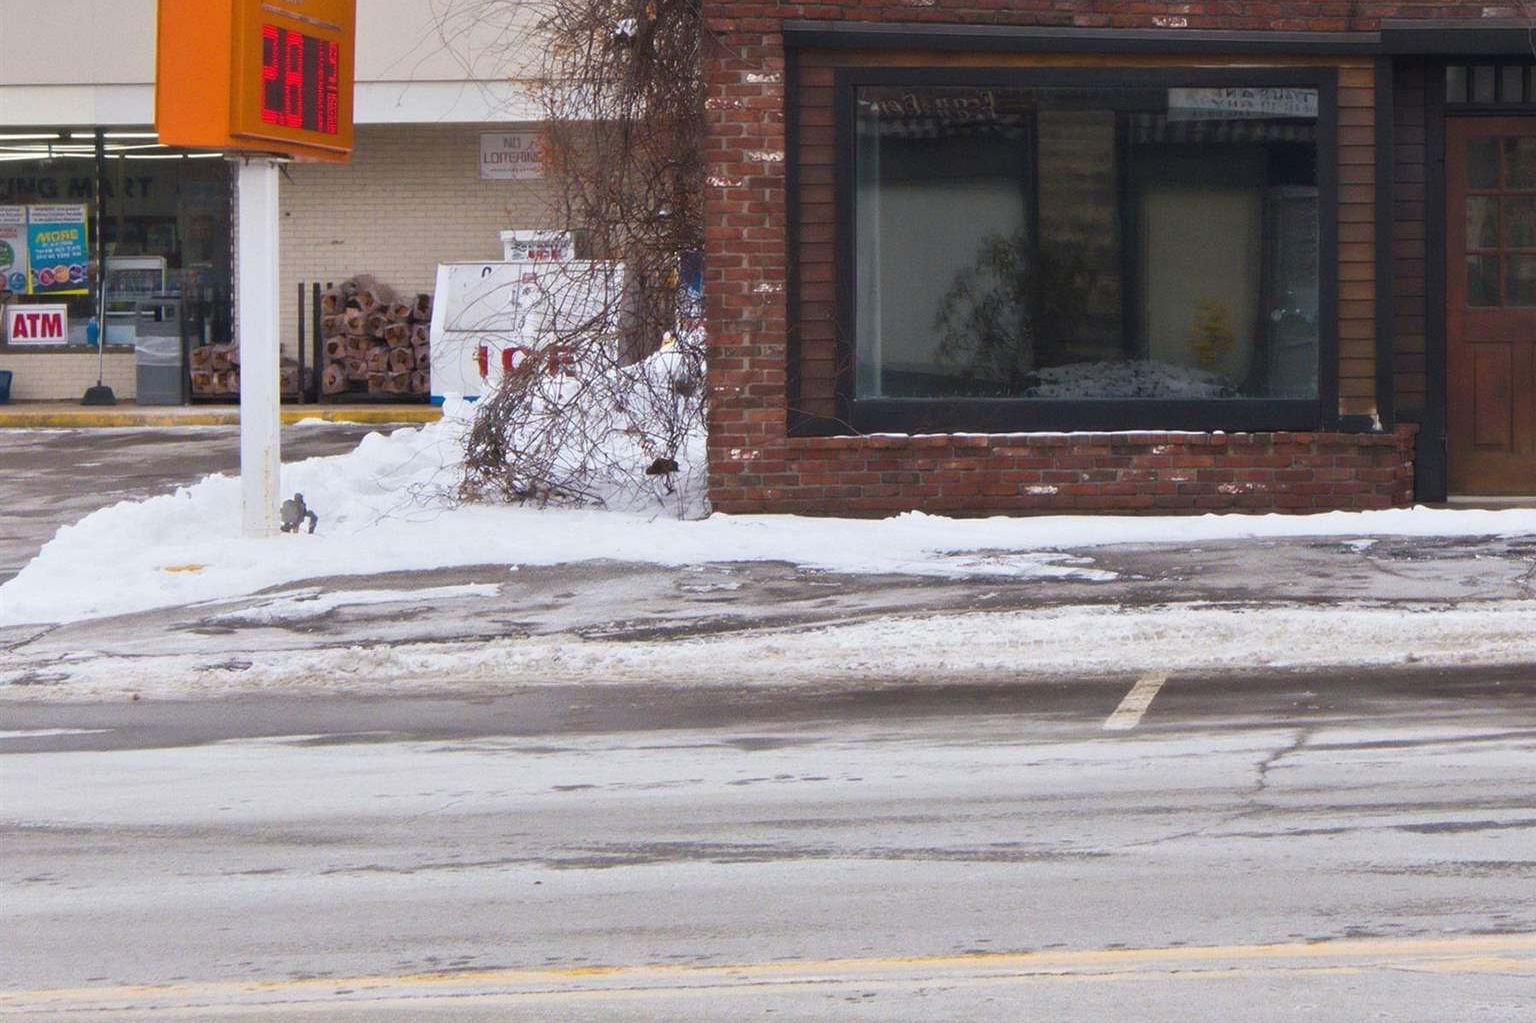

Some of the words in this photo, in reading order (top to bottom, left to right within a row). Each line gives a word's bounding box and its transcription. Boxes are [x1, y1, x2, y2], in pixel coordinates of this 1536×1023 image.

[503, 136, 521, 149] NO
[67, 177, 152, 198] MART
[36, 228, 79, 244] MORE
[12, 312, 63, 339] ATM
